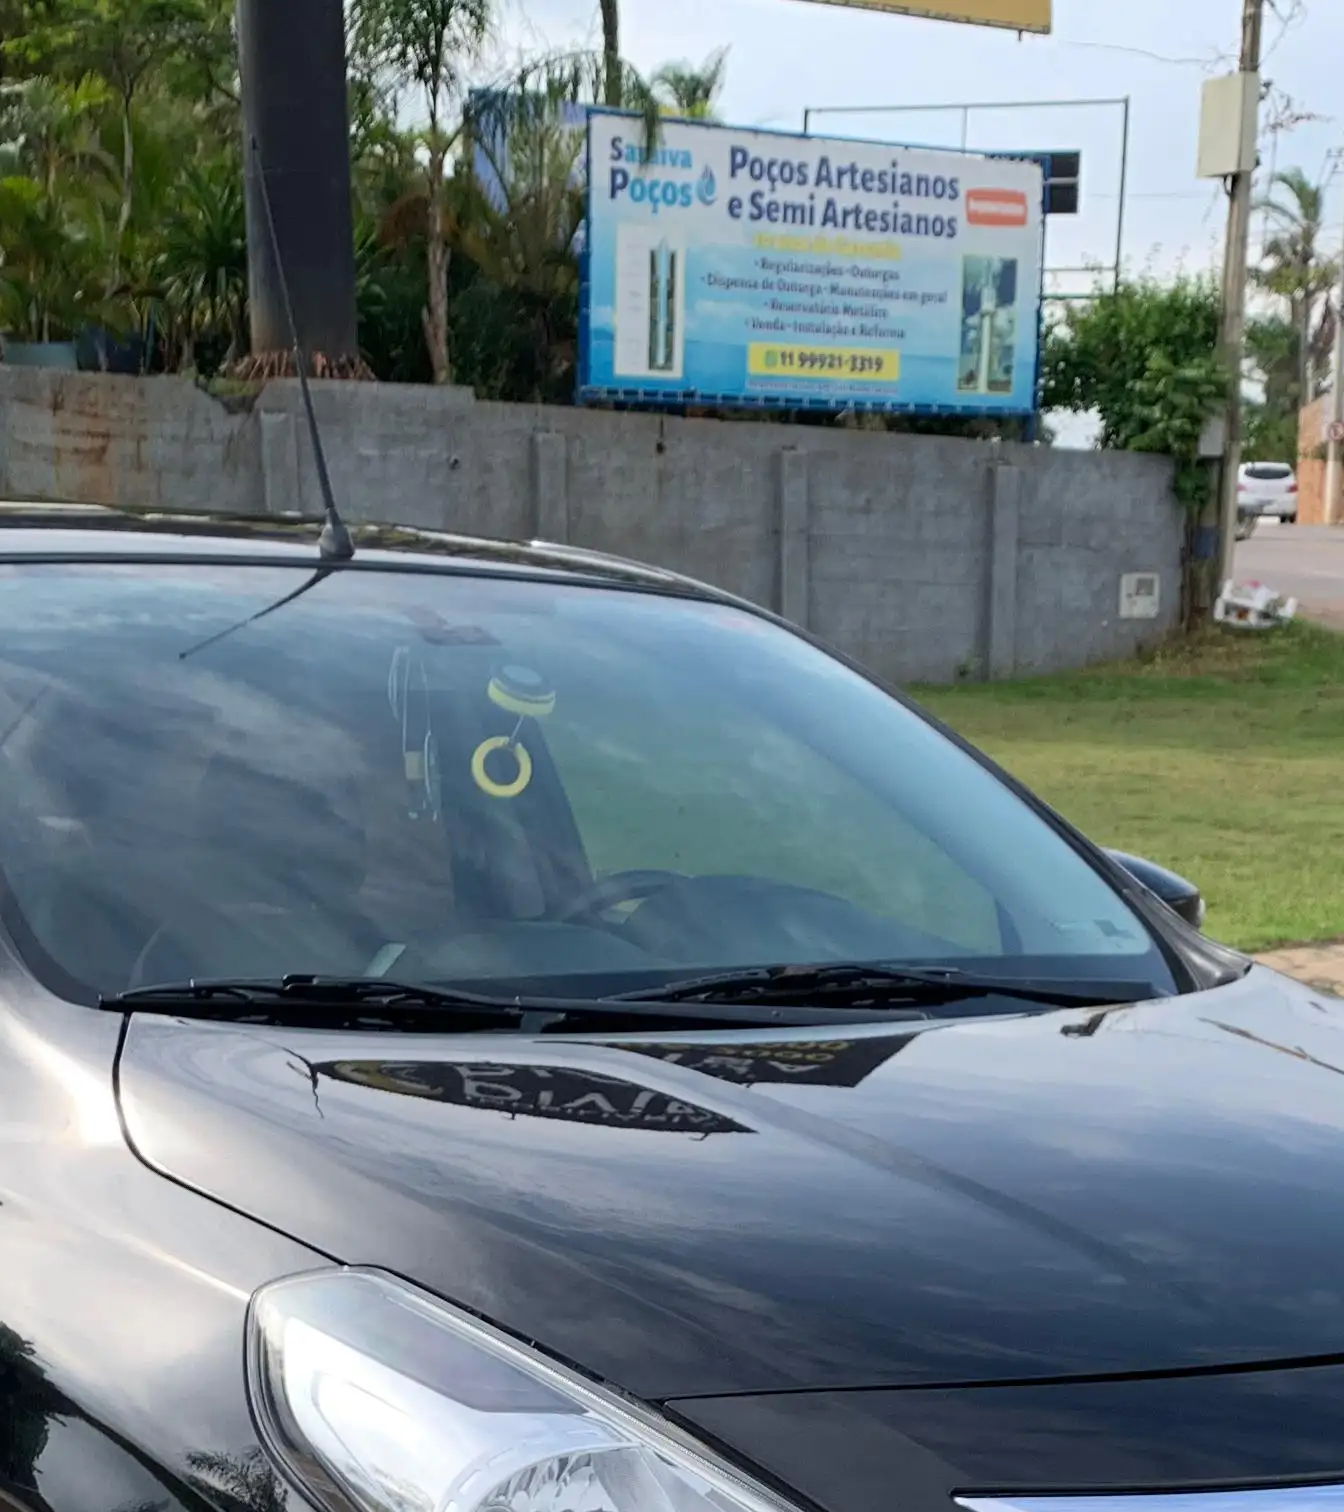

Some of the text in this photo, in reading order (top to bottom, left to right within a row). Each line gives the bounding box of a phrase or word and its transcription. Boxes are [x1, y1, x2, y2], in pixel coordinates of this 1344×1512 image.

[609, 166, 693, 214] Poços
[730, 145, 960, 201] Poços Artesianos
[728, 195, 743, 219] e
[749, 190, 815, 226] Semi
[821, 199, 957, 239] Artesianos
[780, 351, 884, 373] 11 99921-3319
